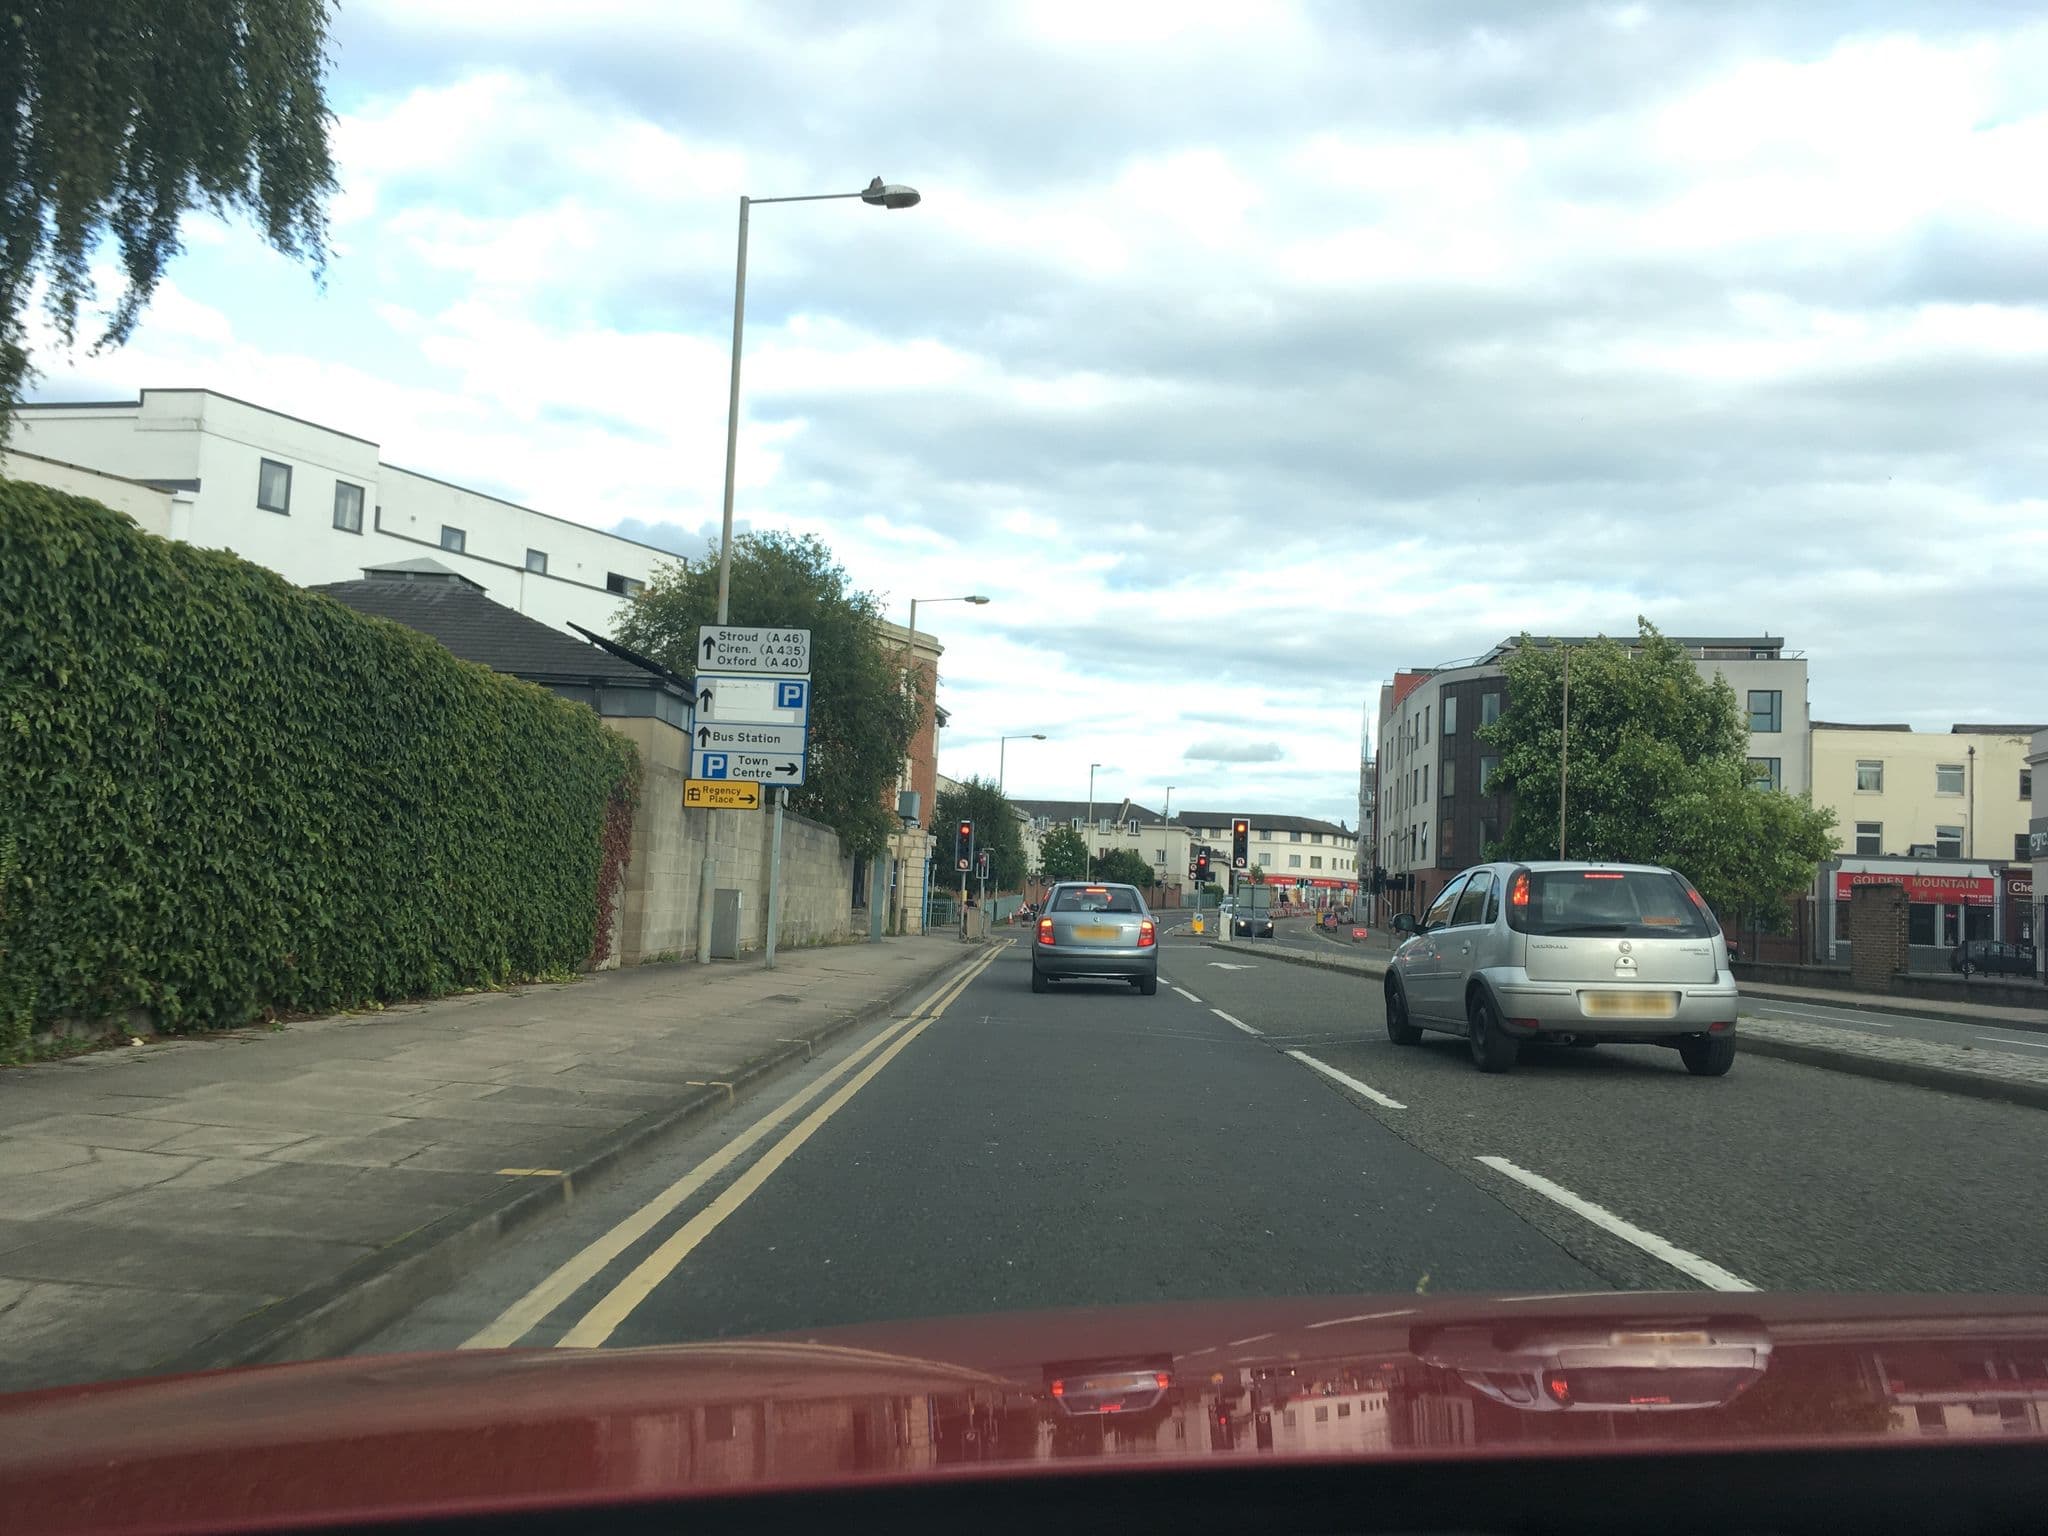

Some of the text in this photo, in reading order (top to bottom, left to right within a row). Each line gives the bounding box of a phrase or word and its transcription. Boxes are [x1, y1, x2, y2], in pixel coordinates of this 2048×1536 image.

[719, 631, 759, 642] Stroud
[717, 643, 752, 654] Ciren.
[717, 655, 757, 666] Oxford
[783, 685, 801, 706] P
[712, 731, 781, 744] Bus Station
[738, 755, 769, 766] Town
[707, 756, 725, 777] P
[732, 767, 773, 778] Centre
[702, 785, 741, 797] Regency
[709, 795, 734, 804] Place
[1912, 877, 1979, 890] MOUNTAIN
